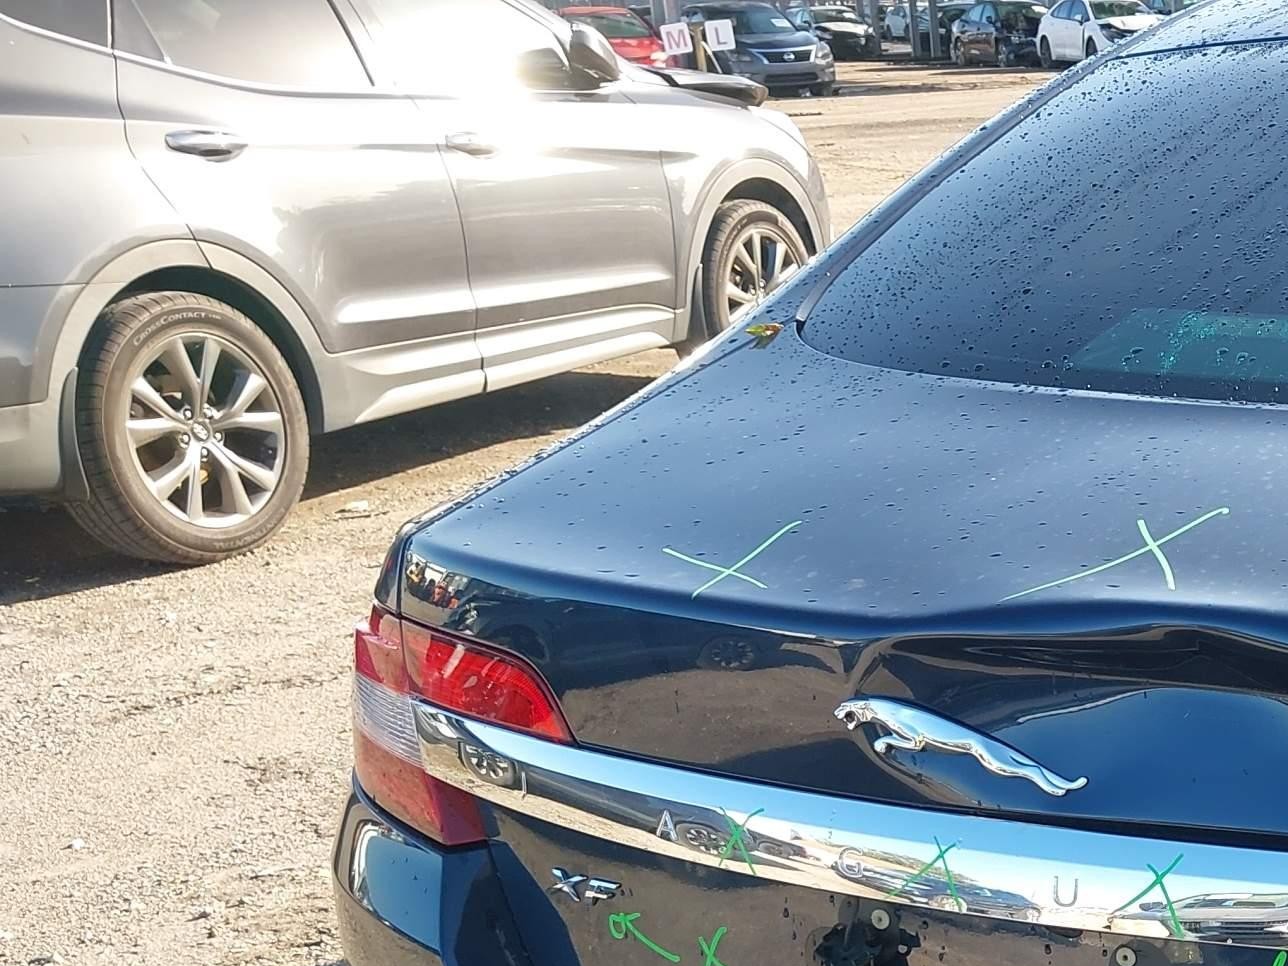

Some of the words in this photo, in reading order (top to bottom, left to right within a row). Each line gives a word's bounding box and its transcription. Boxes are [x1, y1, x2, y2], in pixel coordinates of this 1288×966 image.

[665, 29, 688, 49] M
[714, 26, 728, 45] L
[550, 867, 622, 905] XF
